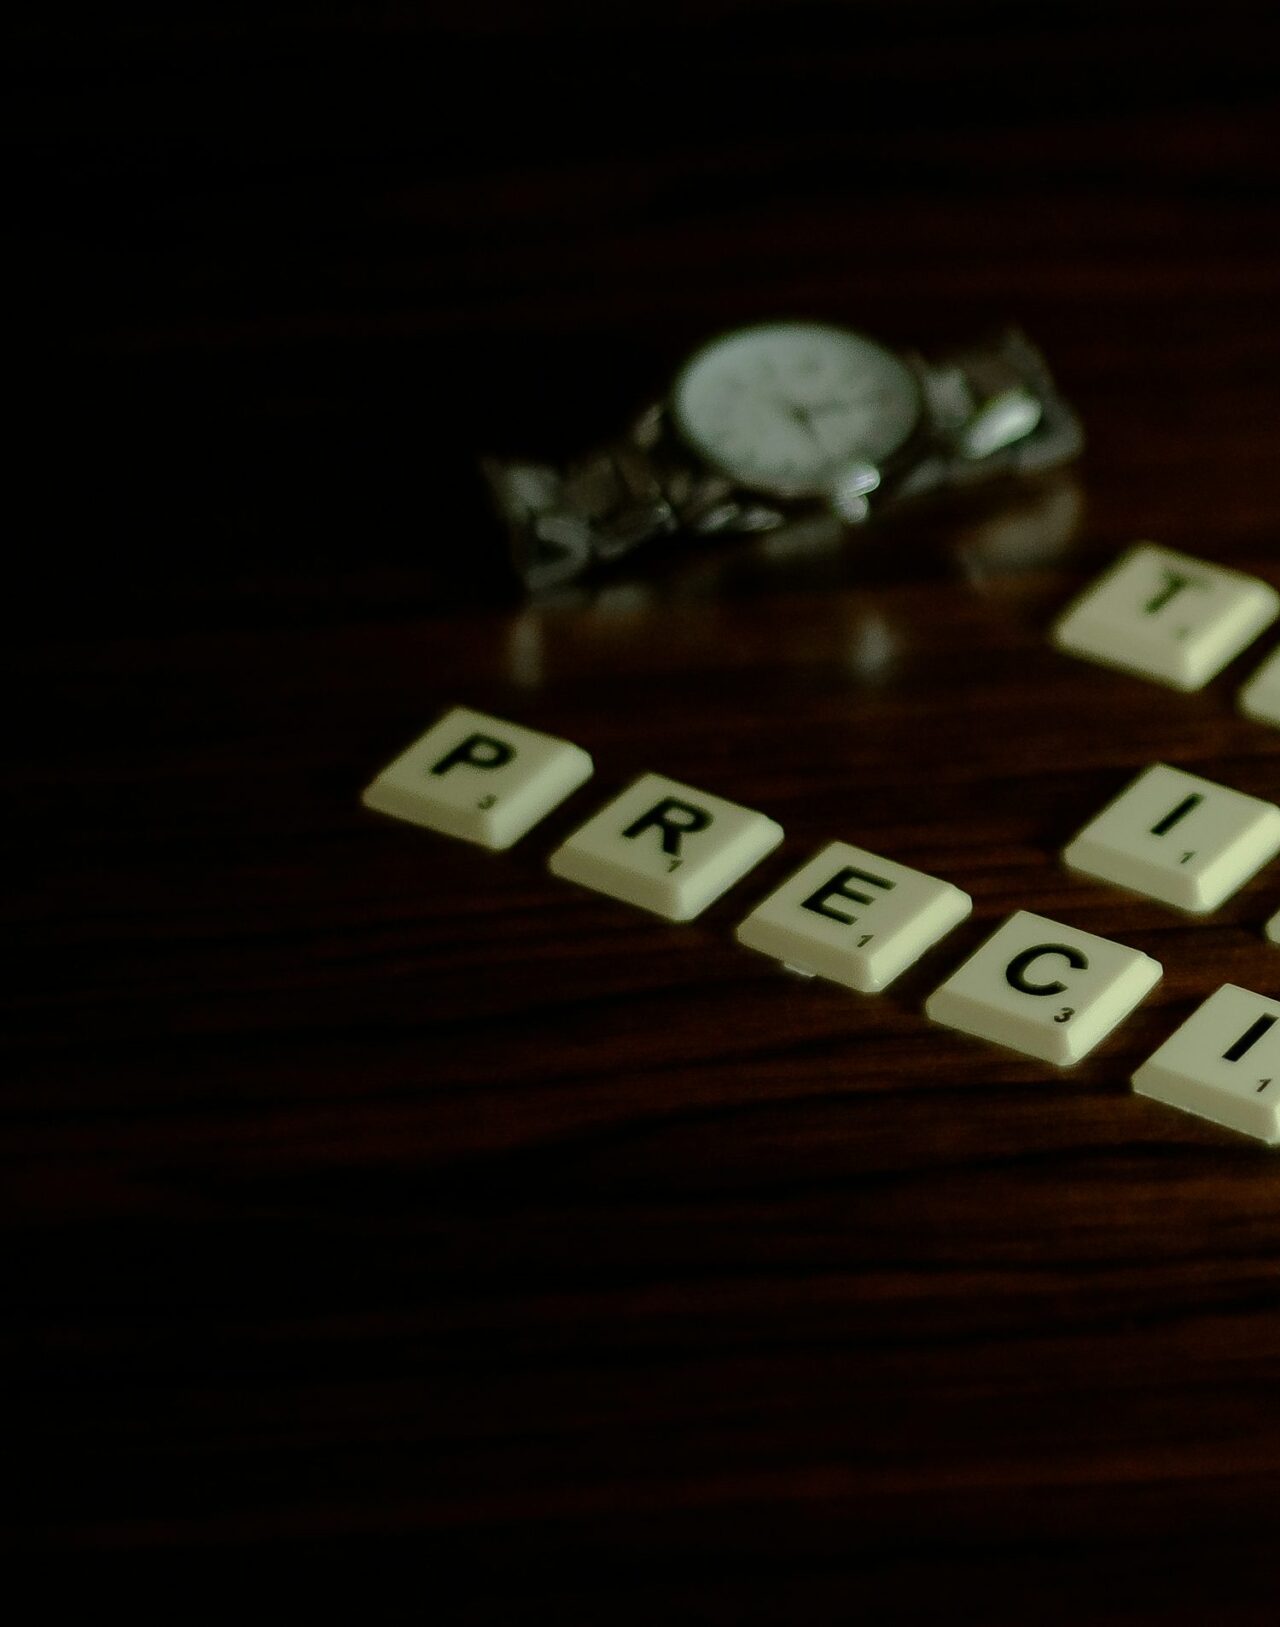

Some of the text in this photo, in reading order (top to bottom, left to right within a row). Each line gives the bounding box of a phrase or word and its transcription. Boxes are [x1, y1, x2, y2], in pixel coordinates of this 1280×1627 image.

[1180, 851, 1195, 865] 1
[667, 859, 683, 874] 1
[857, 935, 874, 948] 1
[1053, 1007, 1075, 1024] 3
[1257, 1078, 1272, 1093] 1
